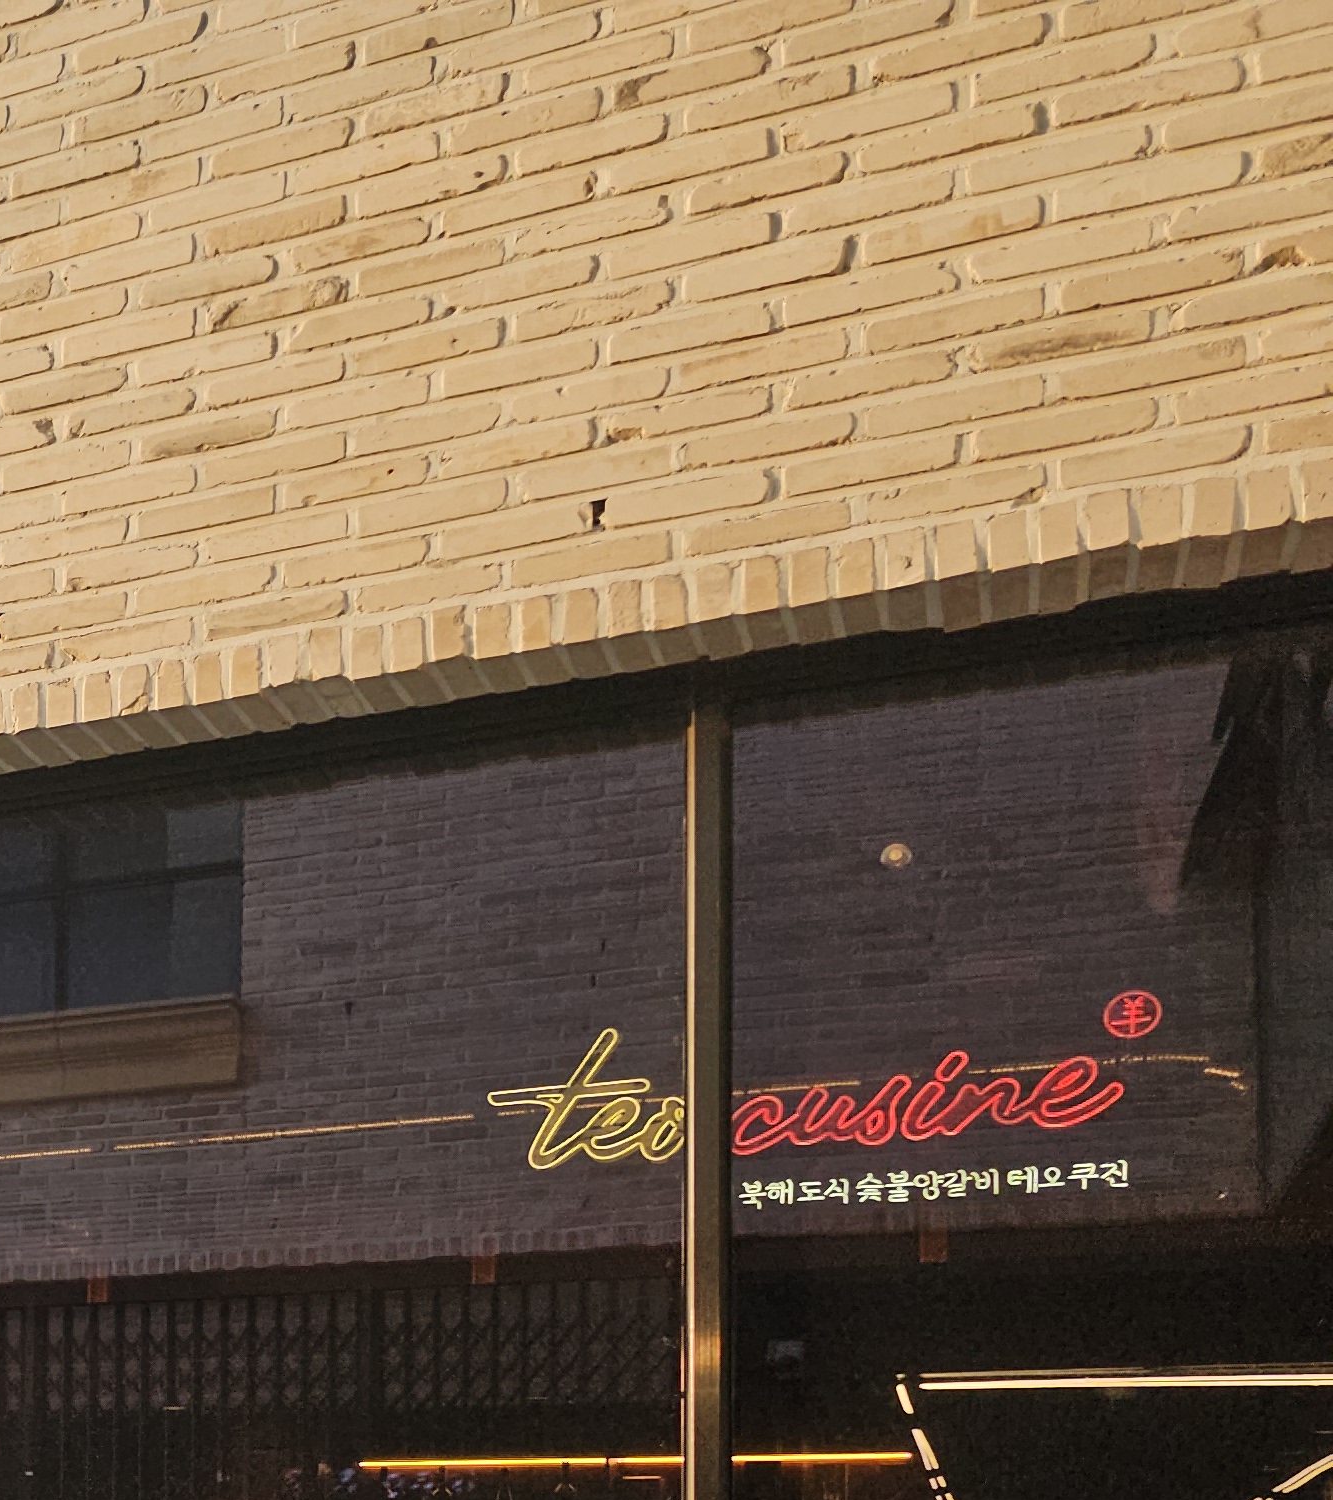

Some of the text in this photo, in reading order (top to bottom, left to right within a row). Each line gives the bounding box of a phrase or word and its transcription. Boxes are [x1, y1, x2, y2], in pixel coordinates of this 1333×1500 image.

[488, 1027, 1125, 1170] teo cusine
[738, 1160, 1130, 1209] 북해도식 숯불양갈비 테오쿠진
